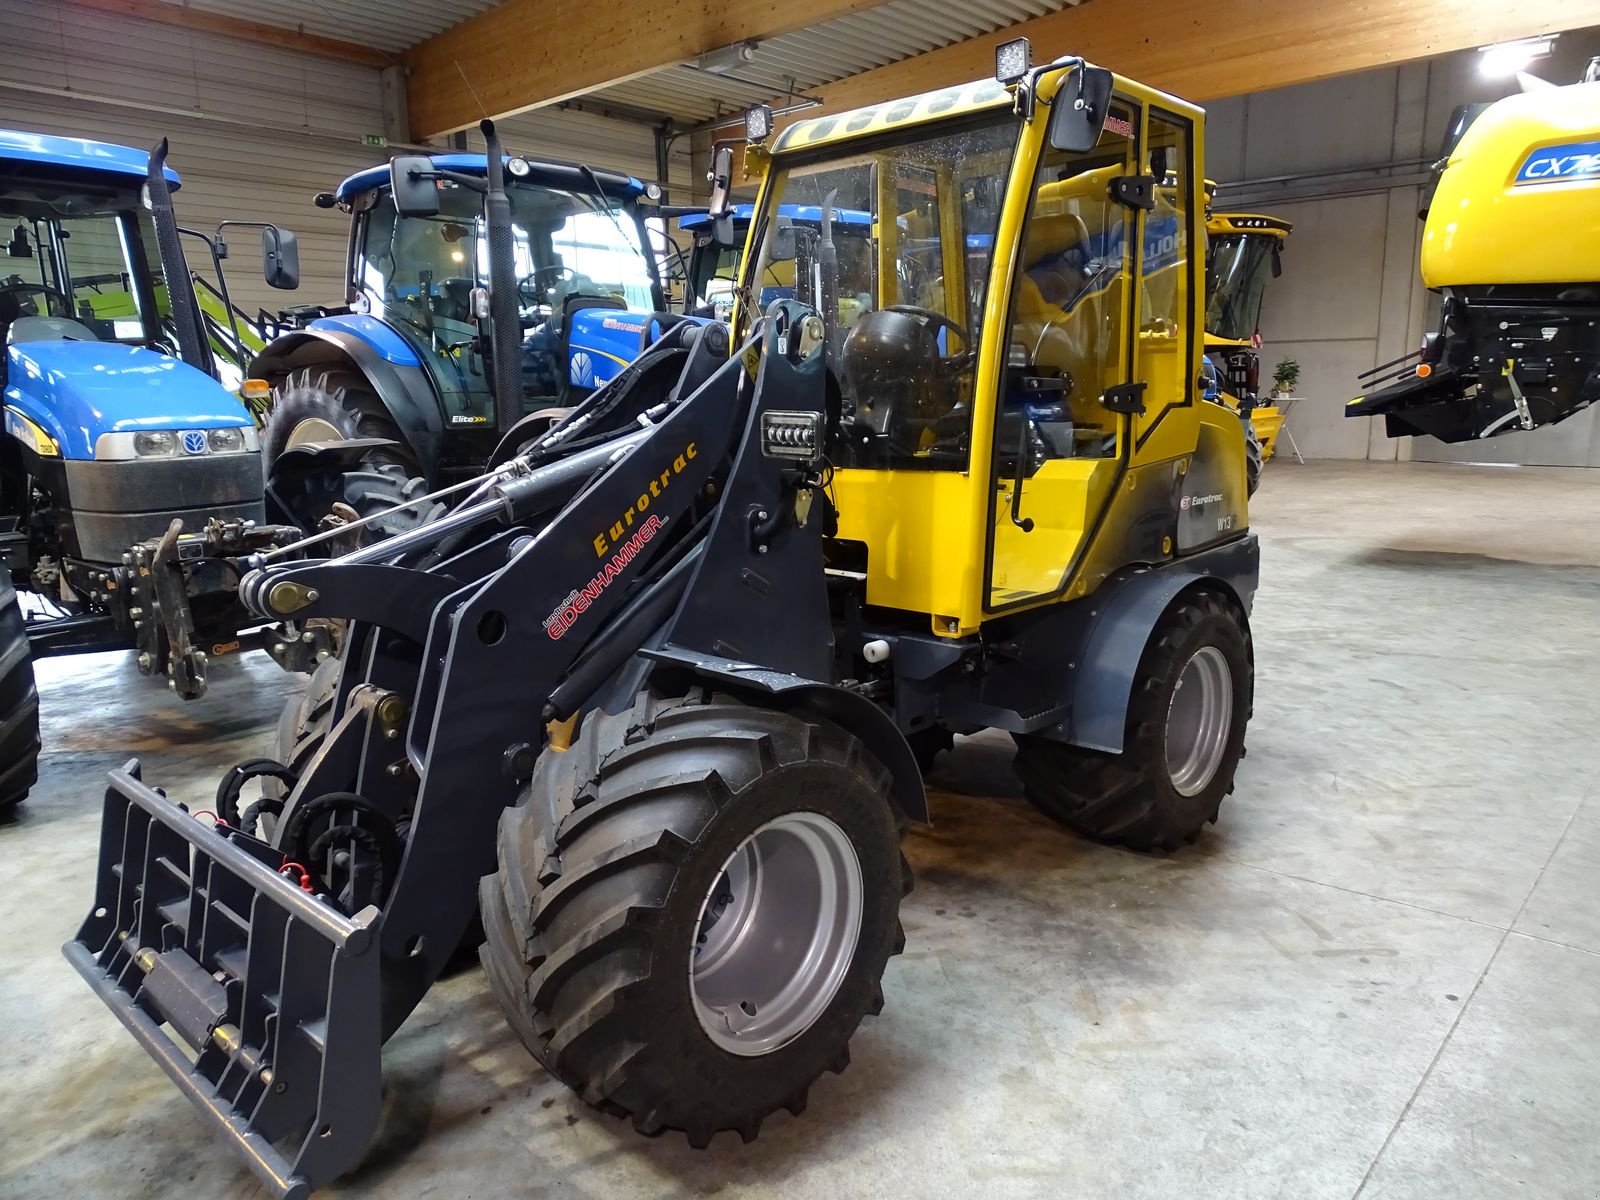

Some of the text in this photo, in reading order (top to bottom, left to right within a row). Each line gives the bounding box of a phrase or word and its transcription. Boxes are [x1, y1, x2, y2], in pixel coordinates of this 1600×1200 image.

[452, 415, 474, 423] Elite
[593, 441, 698, 558] Eurotrac
[1191, 493, 1223, 506] Eurotrac
[1217, 515, 1231, 531] W13
[546, 513, 662, 640] EIDENHAMMER
